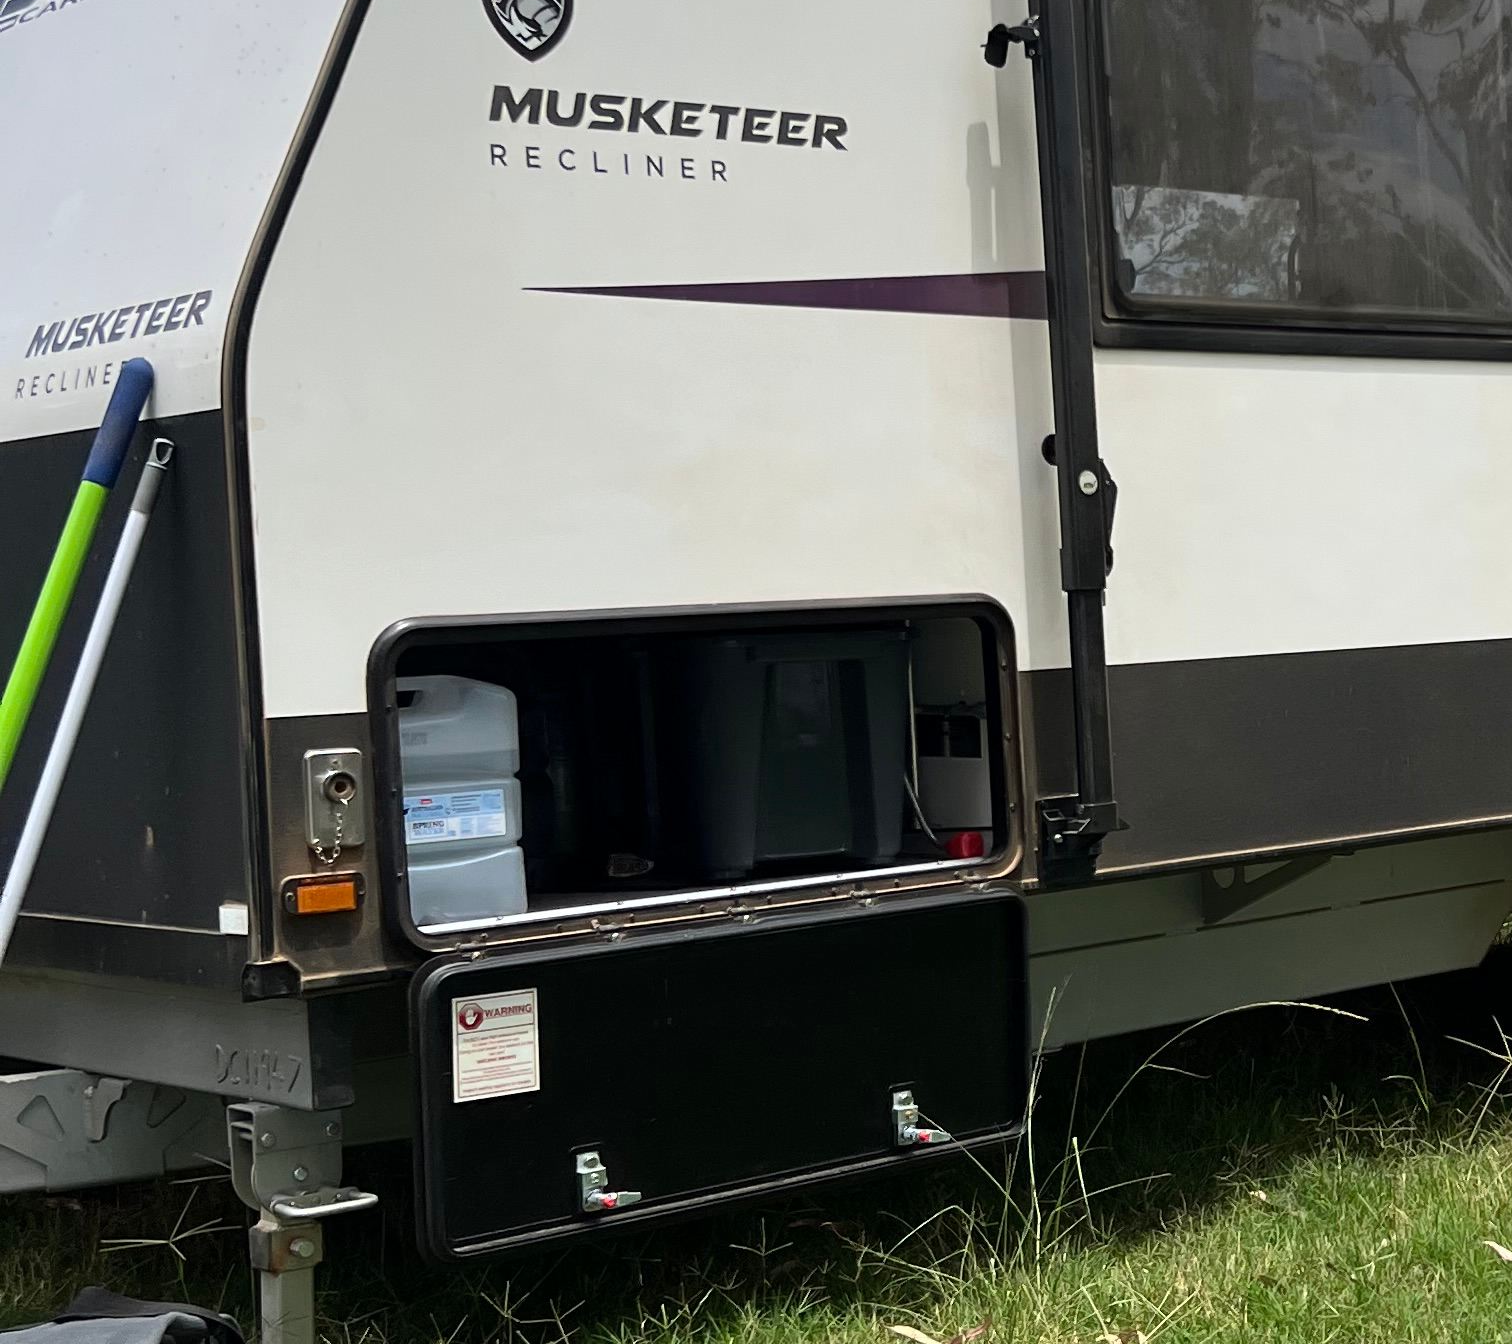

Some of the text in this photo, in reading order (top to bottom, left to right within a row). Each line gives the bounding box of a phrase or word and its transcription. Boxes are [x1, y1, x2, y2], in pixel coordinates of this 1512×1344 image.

[489, 85, 848, 152] MUSKETEER
[489, 143, 728, 183] RECLINER
[25, 289, 213, 359] MUSKETEER
[15, 360, 130, 400] RECLINE
[484, 1003, 532, 1018] WARNING
